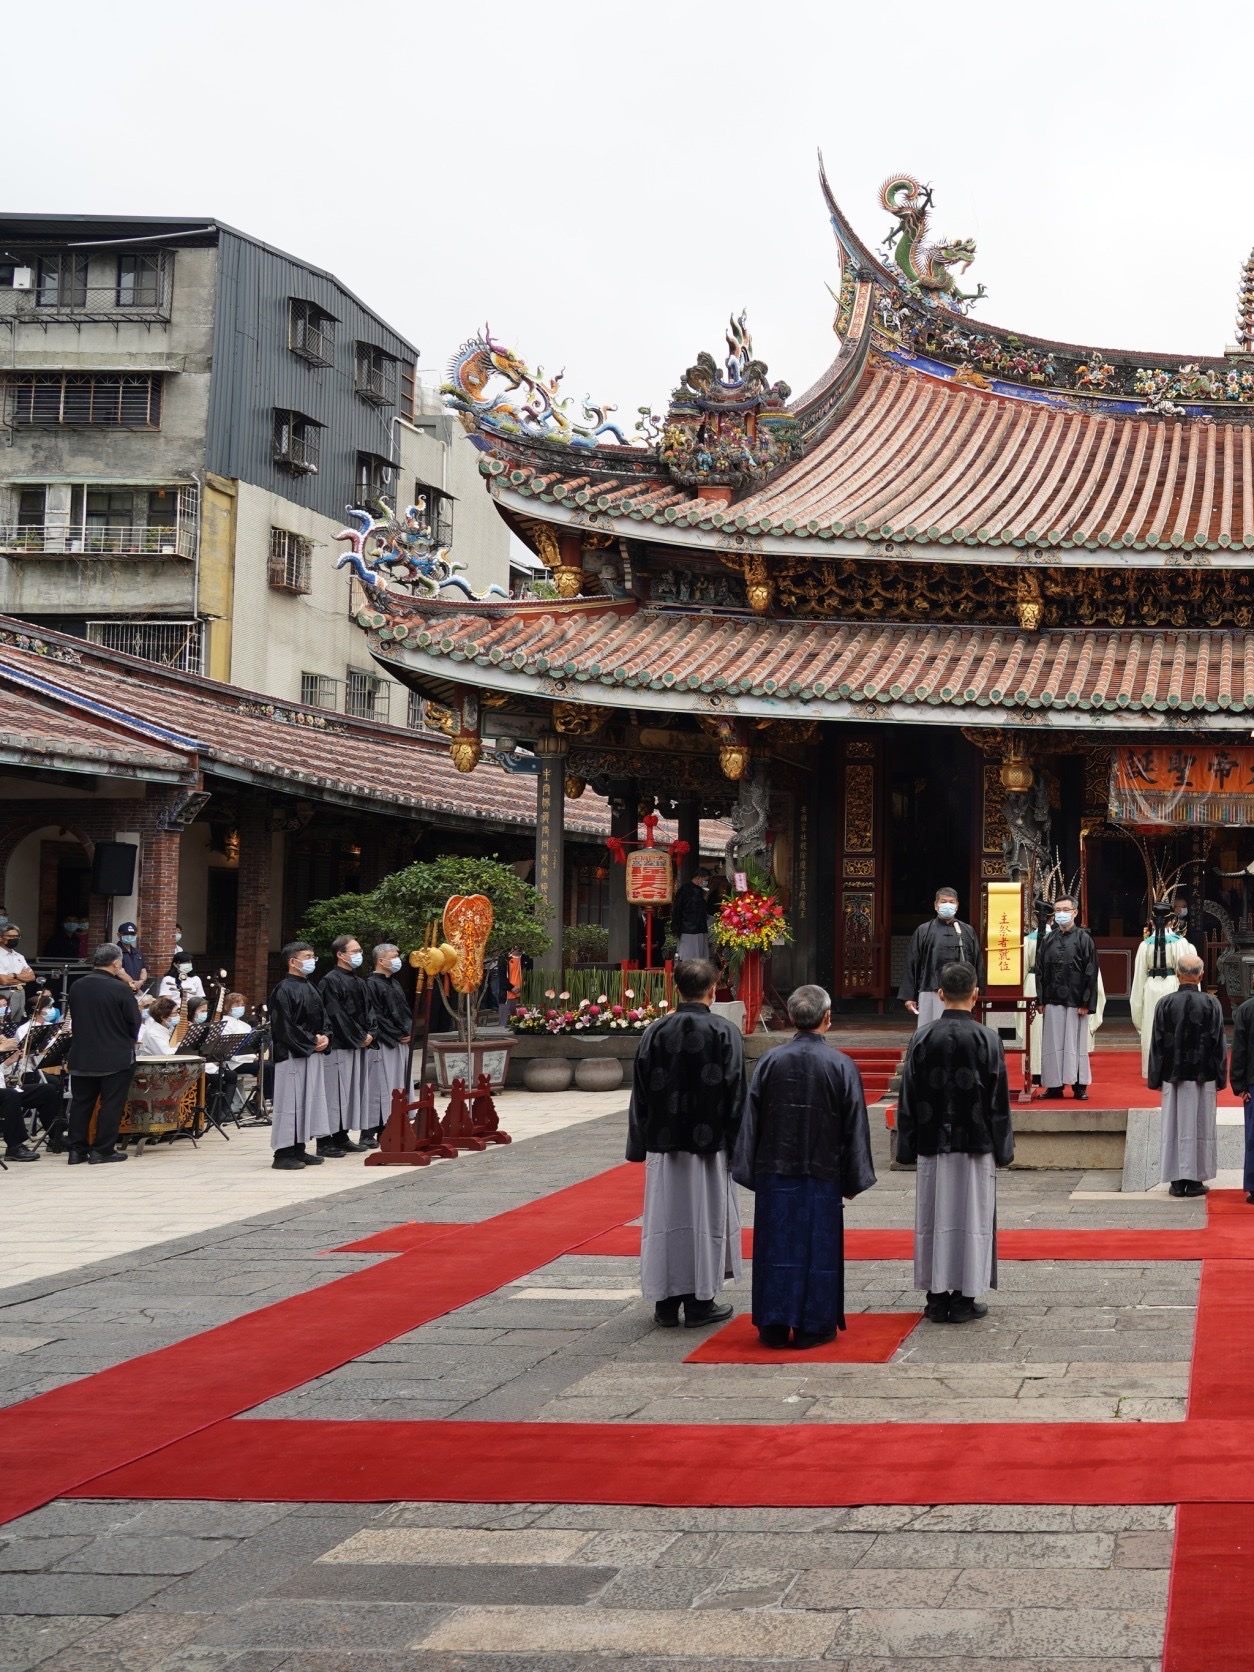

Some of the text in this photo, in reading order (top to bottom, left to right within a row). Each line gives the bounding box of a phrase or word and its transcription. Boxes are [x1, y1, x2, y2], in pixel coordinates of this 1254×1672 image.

[997, 911, 1011, 971] 主祭者就位
